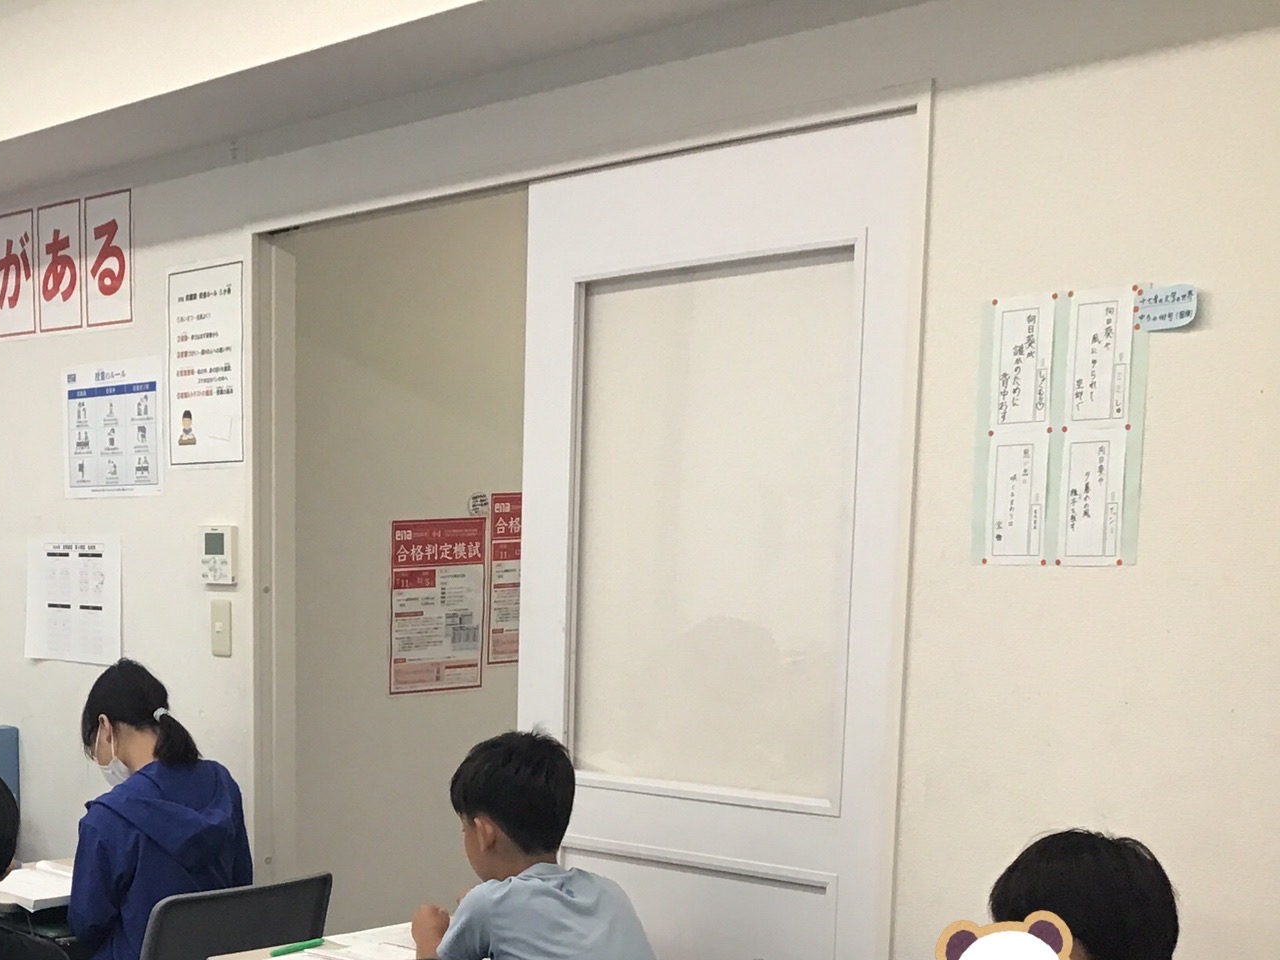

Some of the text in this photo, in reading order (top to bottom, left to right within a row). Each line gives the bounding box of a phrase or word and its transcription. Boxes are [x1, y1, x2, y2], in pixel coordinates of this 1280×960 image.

[395, 541, 482, 563] 合格判定模試
